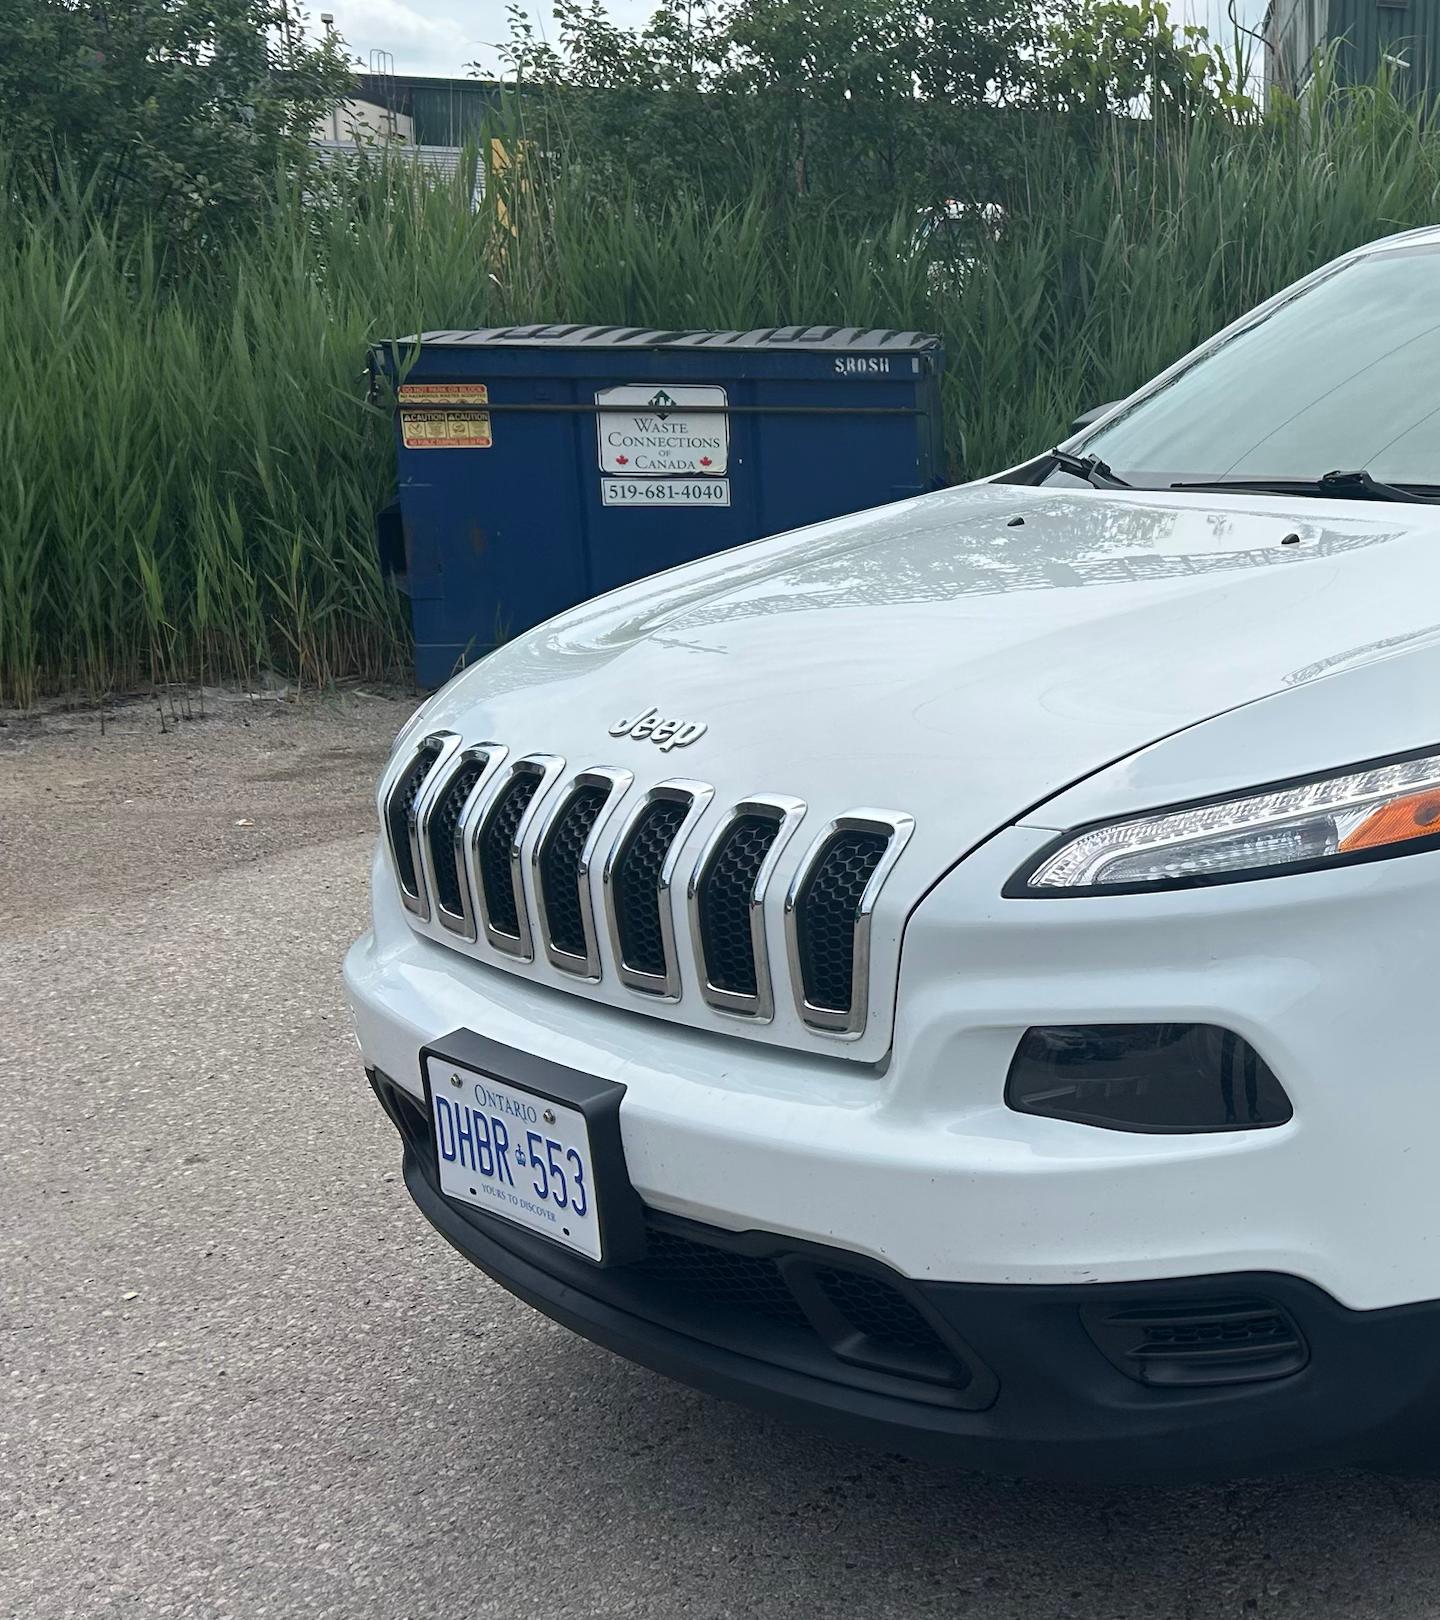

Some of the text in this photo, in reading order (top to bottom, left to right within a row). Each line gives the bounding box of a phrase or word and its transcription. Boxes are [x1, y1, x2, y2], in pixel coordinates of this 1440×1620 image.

[634, 417, 688, 433] WASTE
[608, 432, 720, 448] CONNECTIONS
[635, 455, 696, 470] CANADA
[609, 485, 723, 499] 519-681-4040
[608, 706, 708, 753] Jeep
[474, 1084, 537, 1124] ONTARIO
[436, 1095, 588, 1217] DHBR 553
[481, 1183, 557, 1222] YOURS TO DISCOVER
